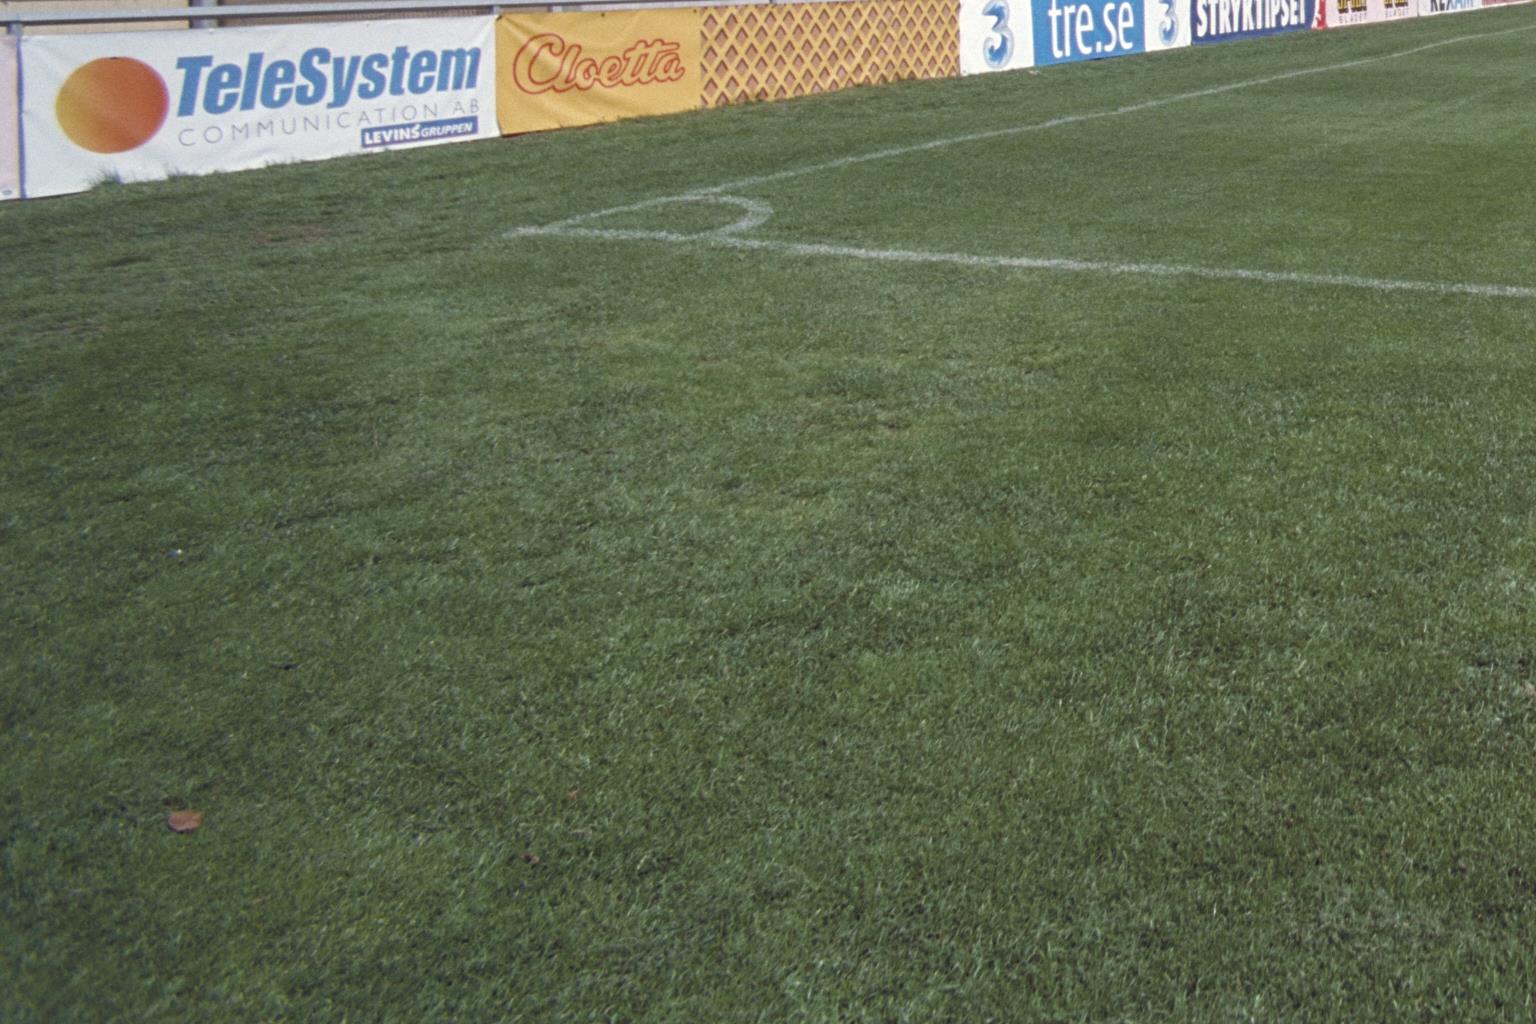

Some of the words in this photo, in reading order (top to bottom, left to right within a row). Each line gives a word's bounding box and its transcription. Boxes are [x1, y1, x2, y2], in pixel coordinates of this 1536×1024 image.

[175, 45, 482, 117] TeleSystem
[513, 33, 685, 95] Cloetta
[178, 103, 439, 147] COMMUNICATION
[453, 98, 480, 114] AB
